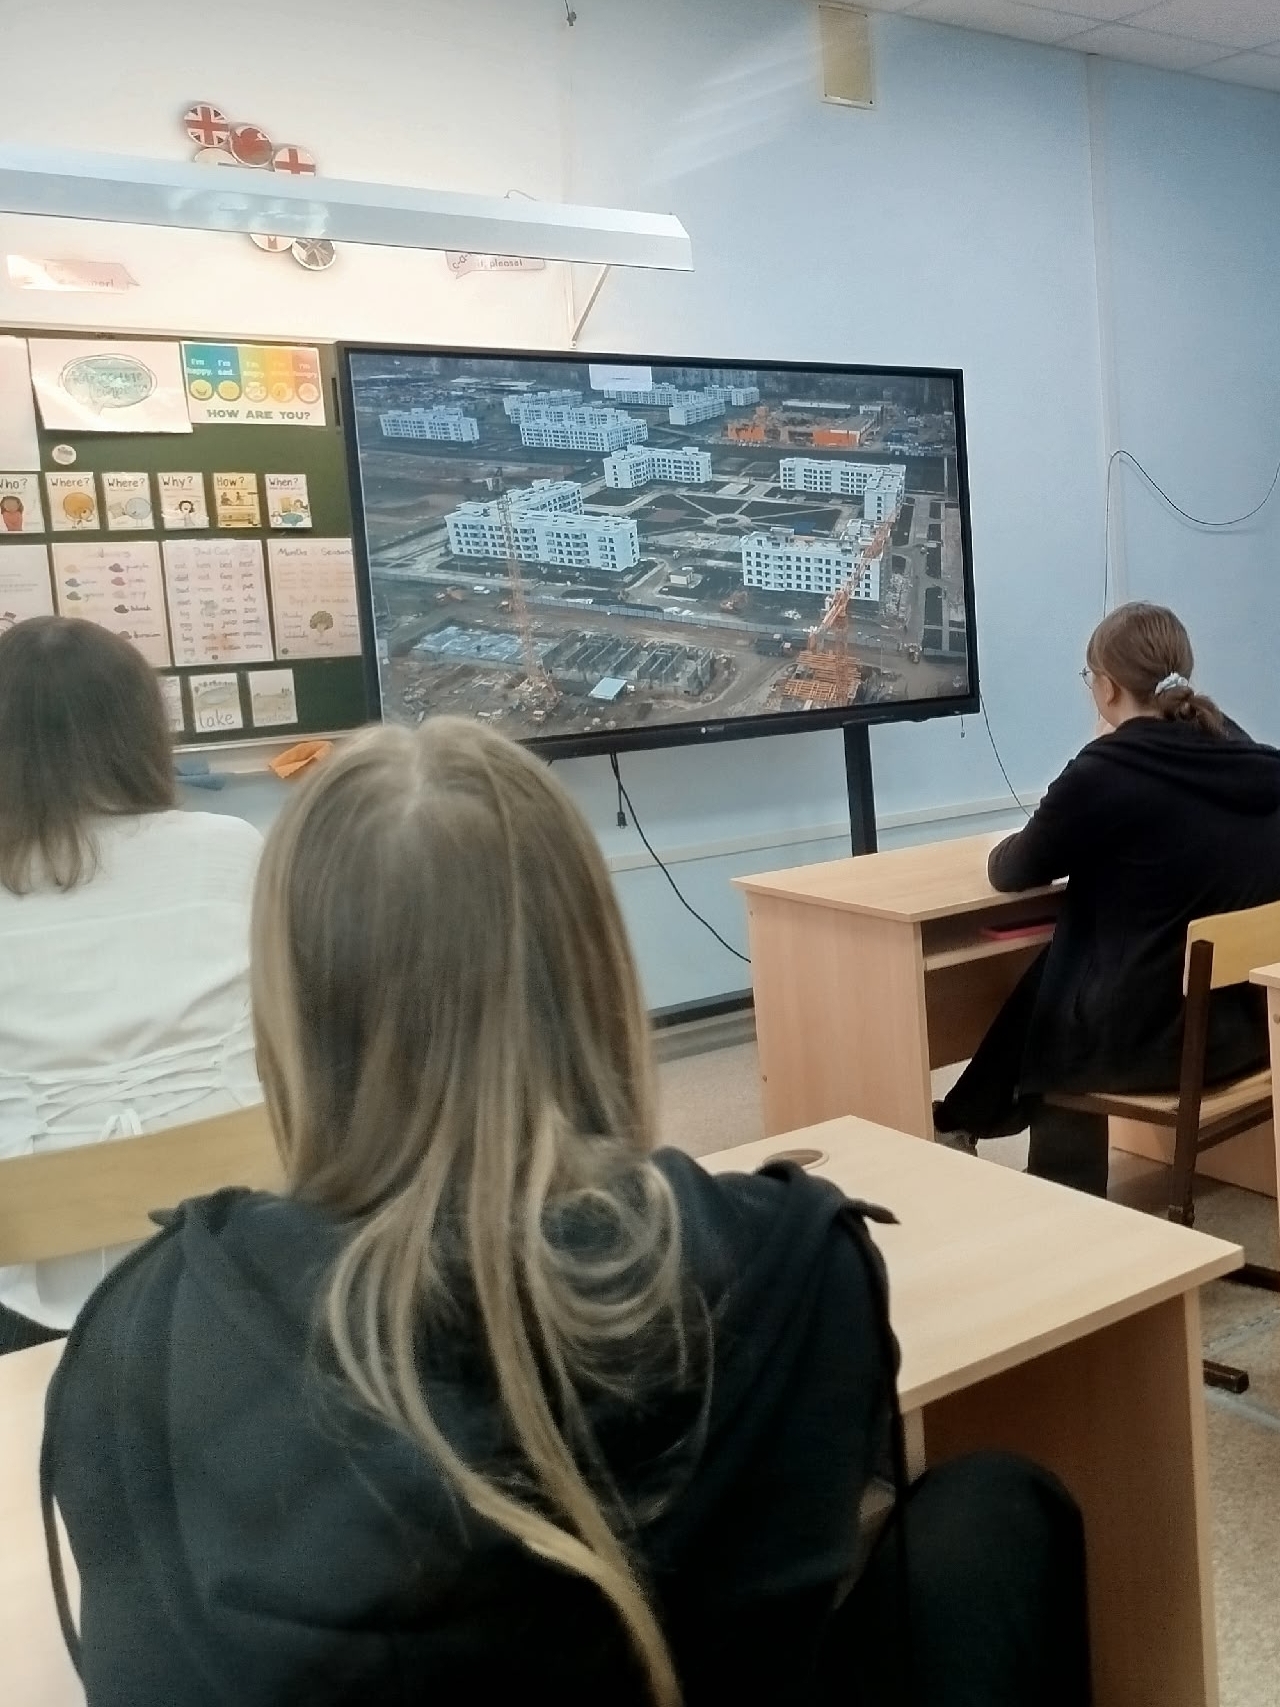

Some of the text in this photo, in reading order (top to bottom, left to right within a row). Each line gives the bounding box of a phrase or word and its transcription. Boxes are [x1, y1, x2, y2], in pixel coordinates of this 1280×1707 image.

[206, 409, 311, 420] HOW ARE YOU?
[50, 476, 90, 488] Where?
[108, 477, 146, 488] Where?
[162, 475, 194, 489] Why?
[216, 476, 245, 487] How?
[268, 477, 299, 487] When?
[200, 708, 235, 729] lake
